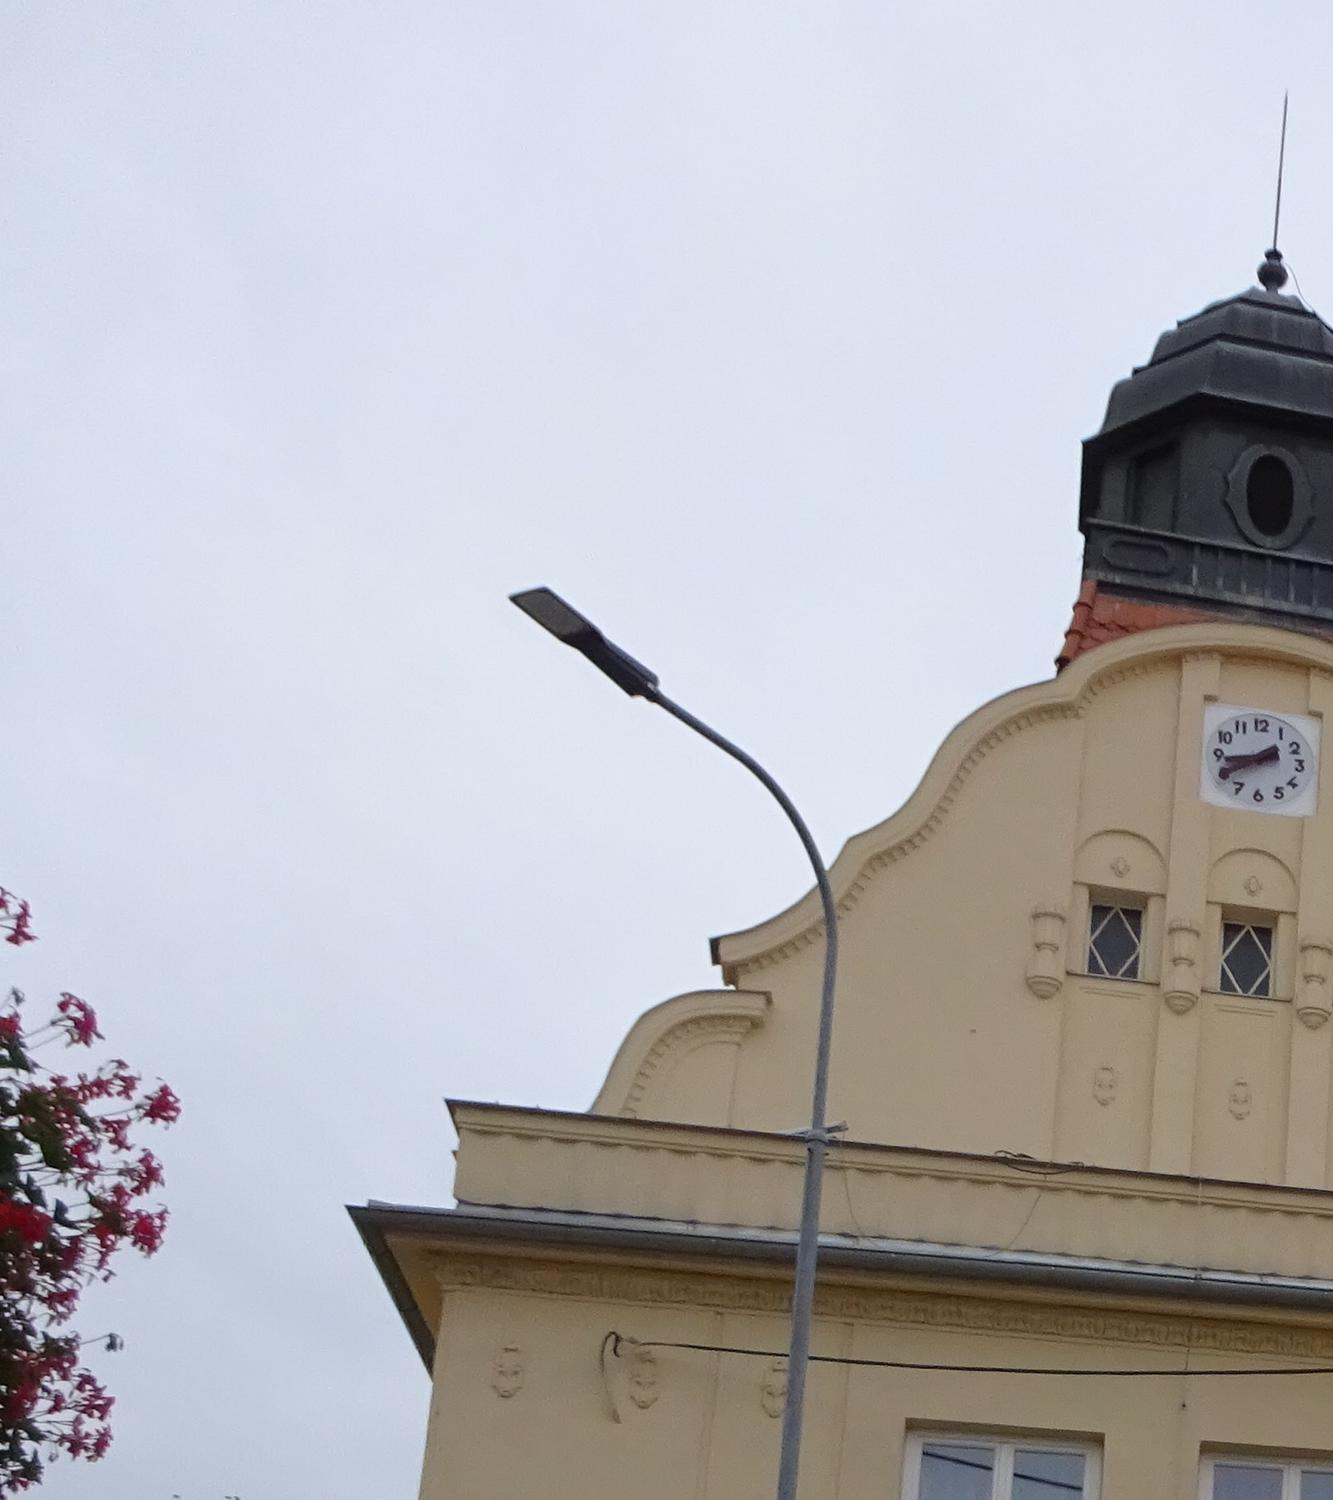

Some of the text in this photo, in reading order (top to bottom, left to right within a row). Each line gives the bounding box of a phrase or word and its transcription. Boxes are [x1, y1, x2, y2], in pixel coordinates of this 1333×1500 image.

[1235, 720, 1247, 734] 11
[1254, 718, 1269, 732] 12
[1218, 731, 1232, 744] 10
[1279, 728, 1283, 740] 1
[1289, 741, 1300, 754] 2
[1213, 748, 1225, 762] 9
[1295, 759, 1305, 772] 3
[1233, 781, 1245, 795] 7
[1286, 776, 1299, 789] 4
[1253, 789, 1264, 801] 6
[1273, 786, 1285, 800] 5
